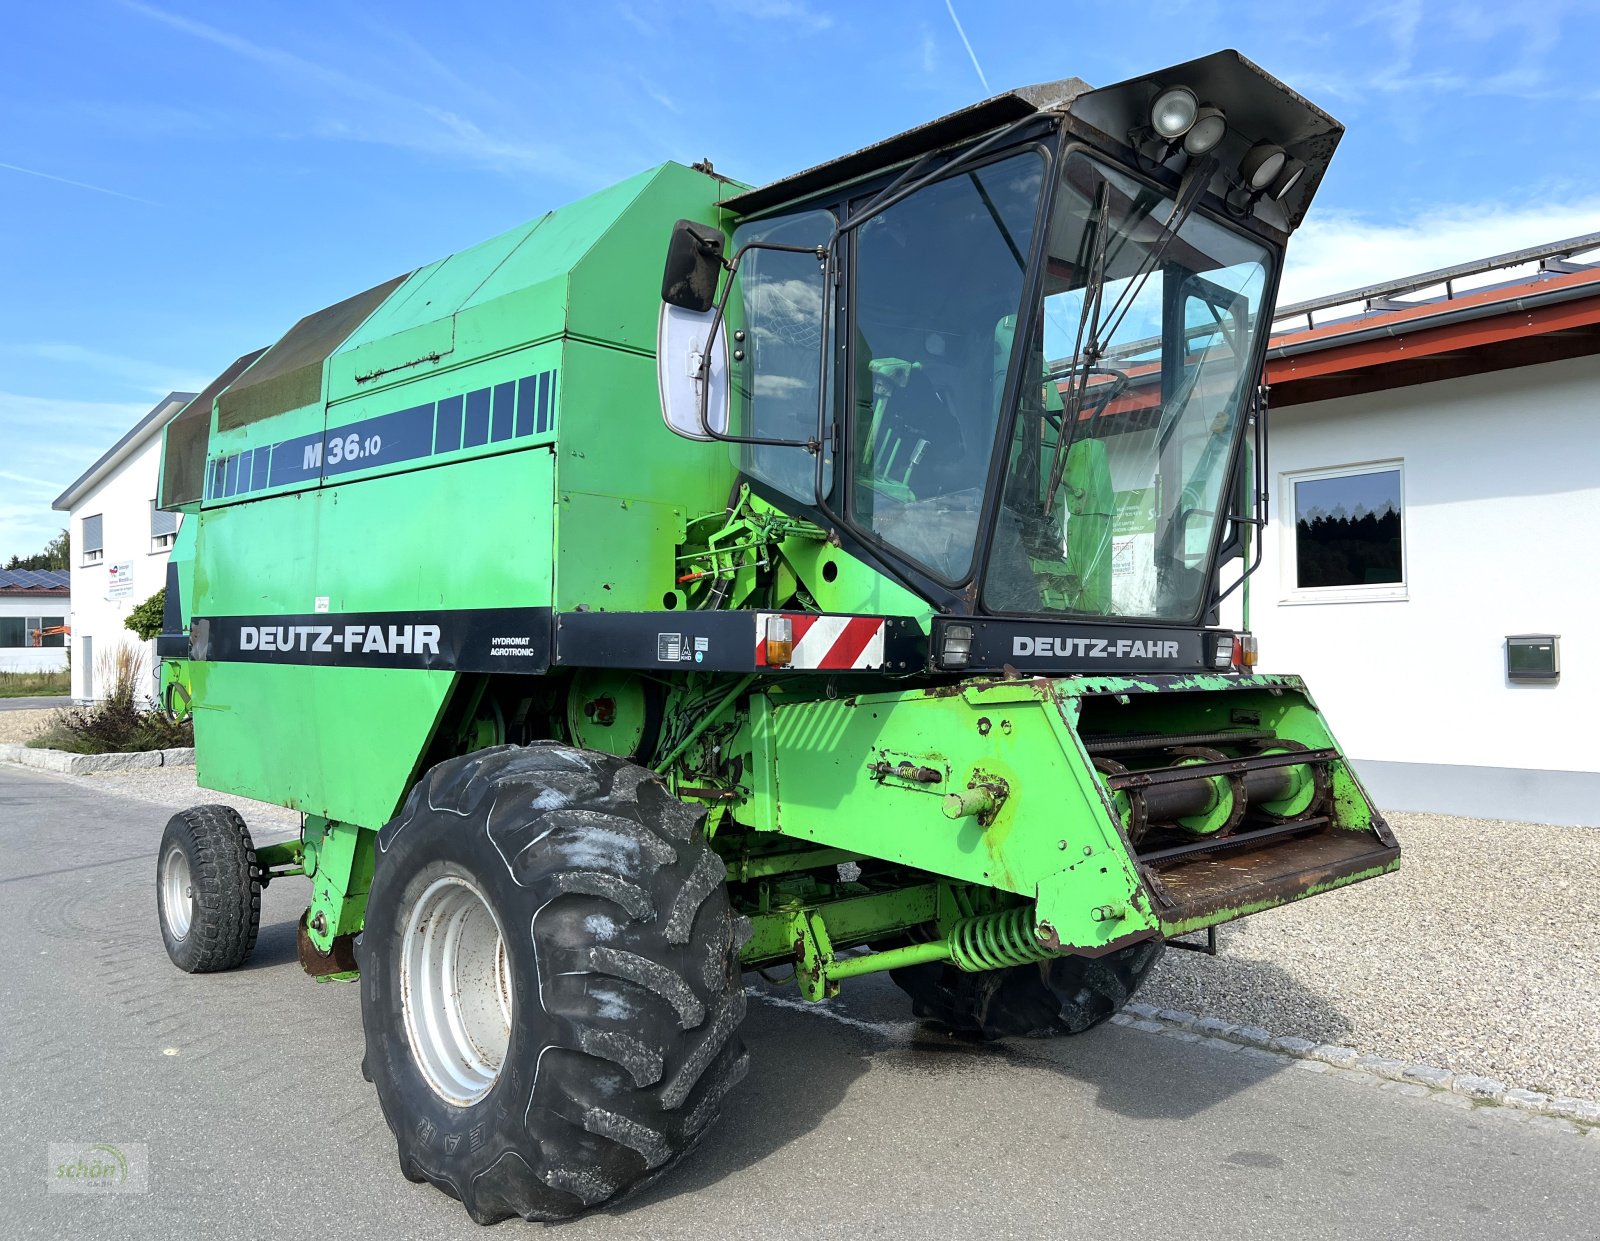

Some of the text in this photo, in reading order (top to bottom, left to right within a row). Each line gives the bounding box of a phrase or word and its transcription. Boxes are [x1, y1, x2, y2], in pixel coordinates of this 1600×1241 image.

[303, 433, 381, 470] M 36.10
[240, 624, 441, 654] DEUTZ-FAHR
[492, 637, 530, 645] HYDROMAT
[1012, 636, 1179, 658] DEUTZ-FAHR
[490, 648, 534, 656] AGROTRONIC
